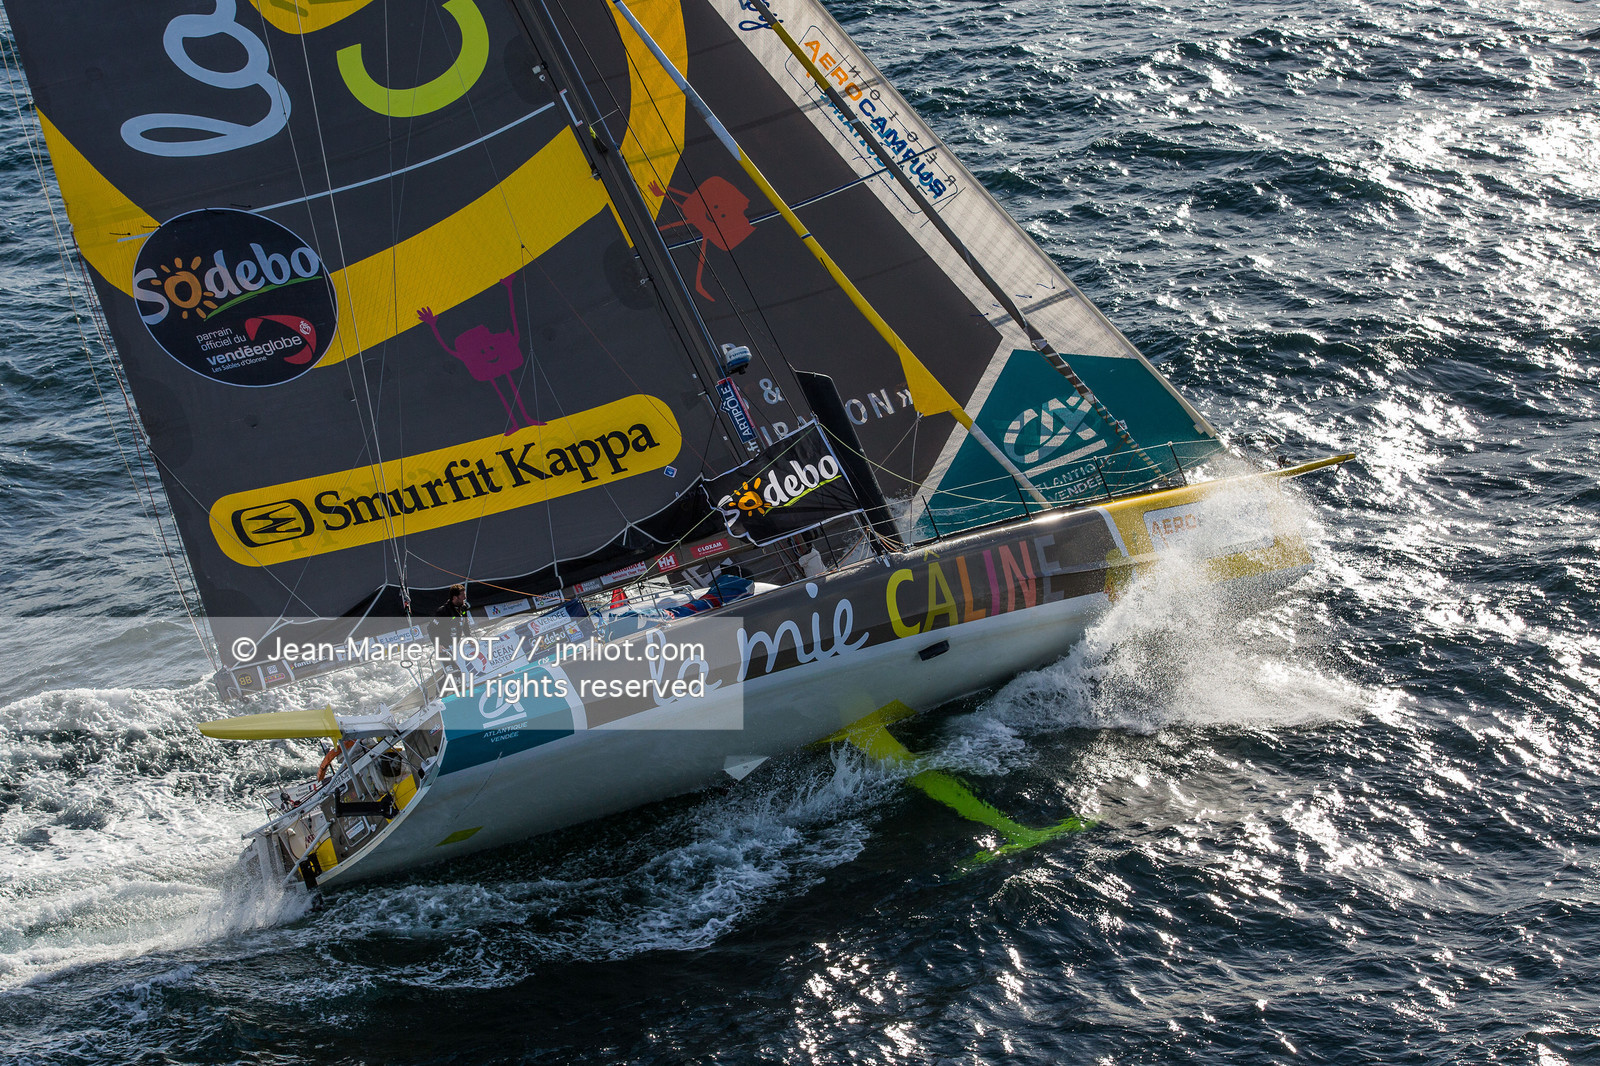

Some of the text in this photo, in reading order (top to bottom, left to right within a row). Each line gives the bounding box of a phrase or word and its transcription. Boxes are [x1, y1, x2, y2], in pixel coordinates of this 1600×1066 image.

[133, 243, 320, 325] Sodebo
[196, 327, 233, 343] parrain
[200, 334, 247, 352] officiel du
[211, 364, 222, 374] Les
[221, 361, 241, 371] Sables
[314, 421, 660, 531] Smurfit Kappa
[736, 582, 870, 682] mie
[885, 534, 1066, 638] CÂLINE
